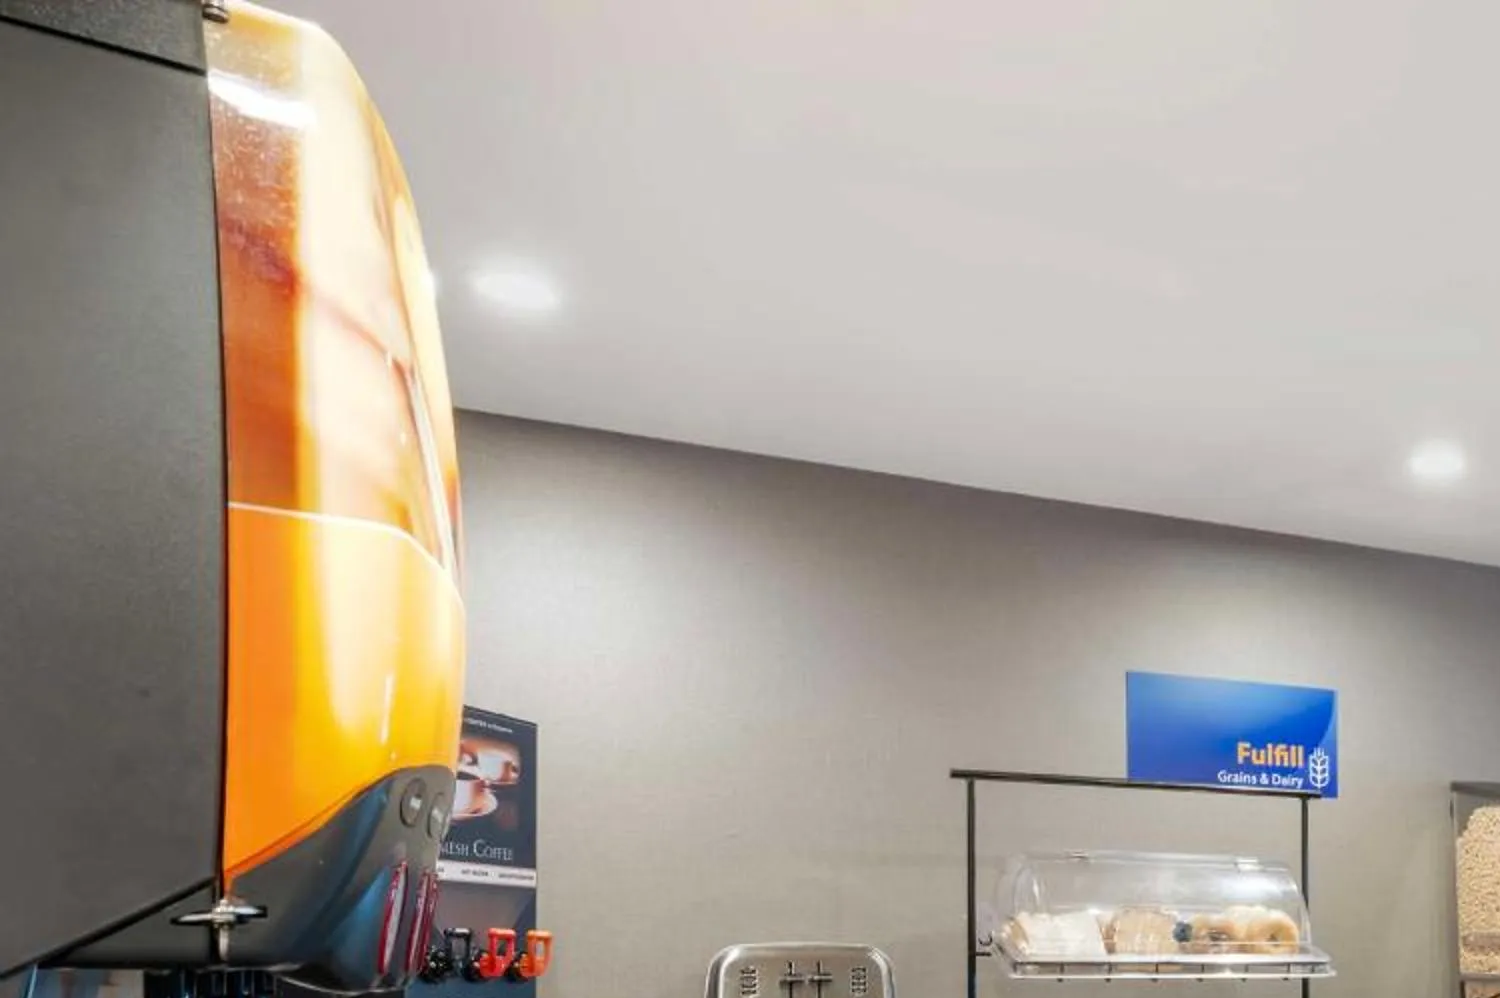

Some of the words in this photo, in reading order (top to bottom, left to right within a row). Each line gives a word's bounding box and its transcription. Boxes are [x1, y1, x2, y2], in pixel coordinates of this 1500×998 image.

[1237, 742, 1304, 768] Fulfill
[1217, 769, 1256, 785] Grains
[1260, 773, 1269, 785] &
[1271, 774, 1304, 789] Dairy
